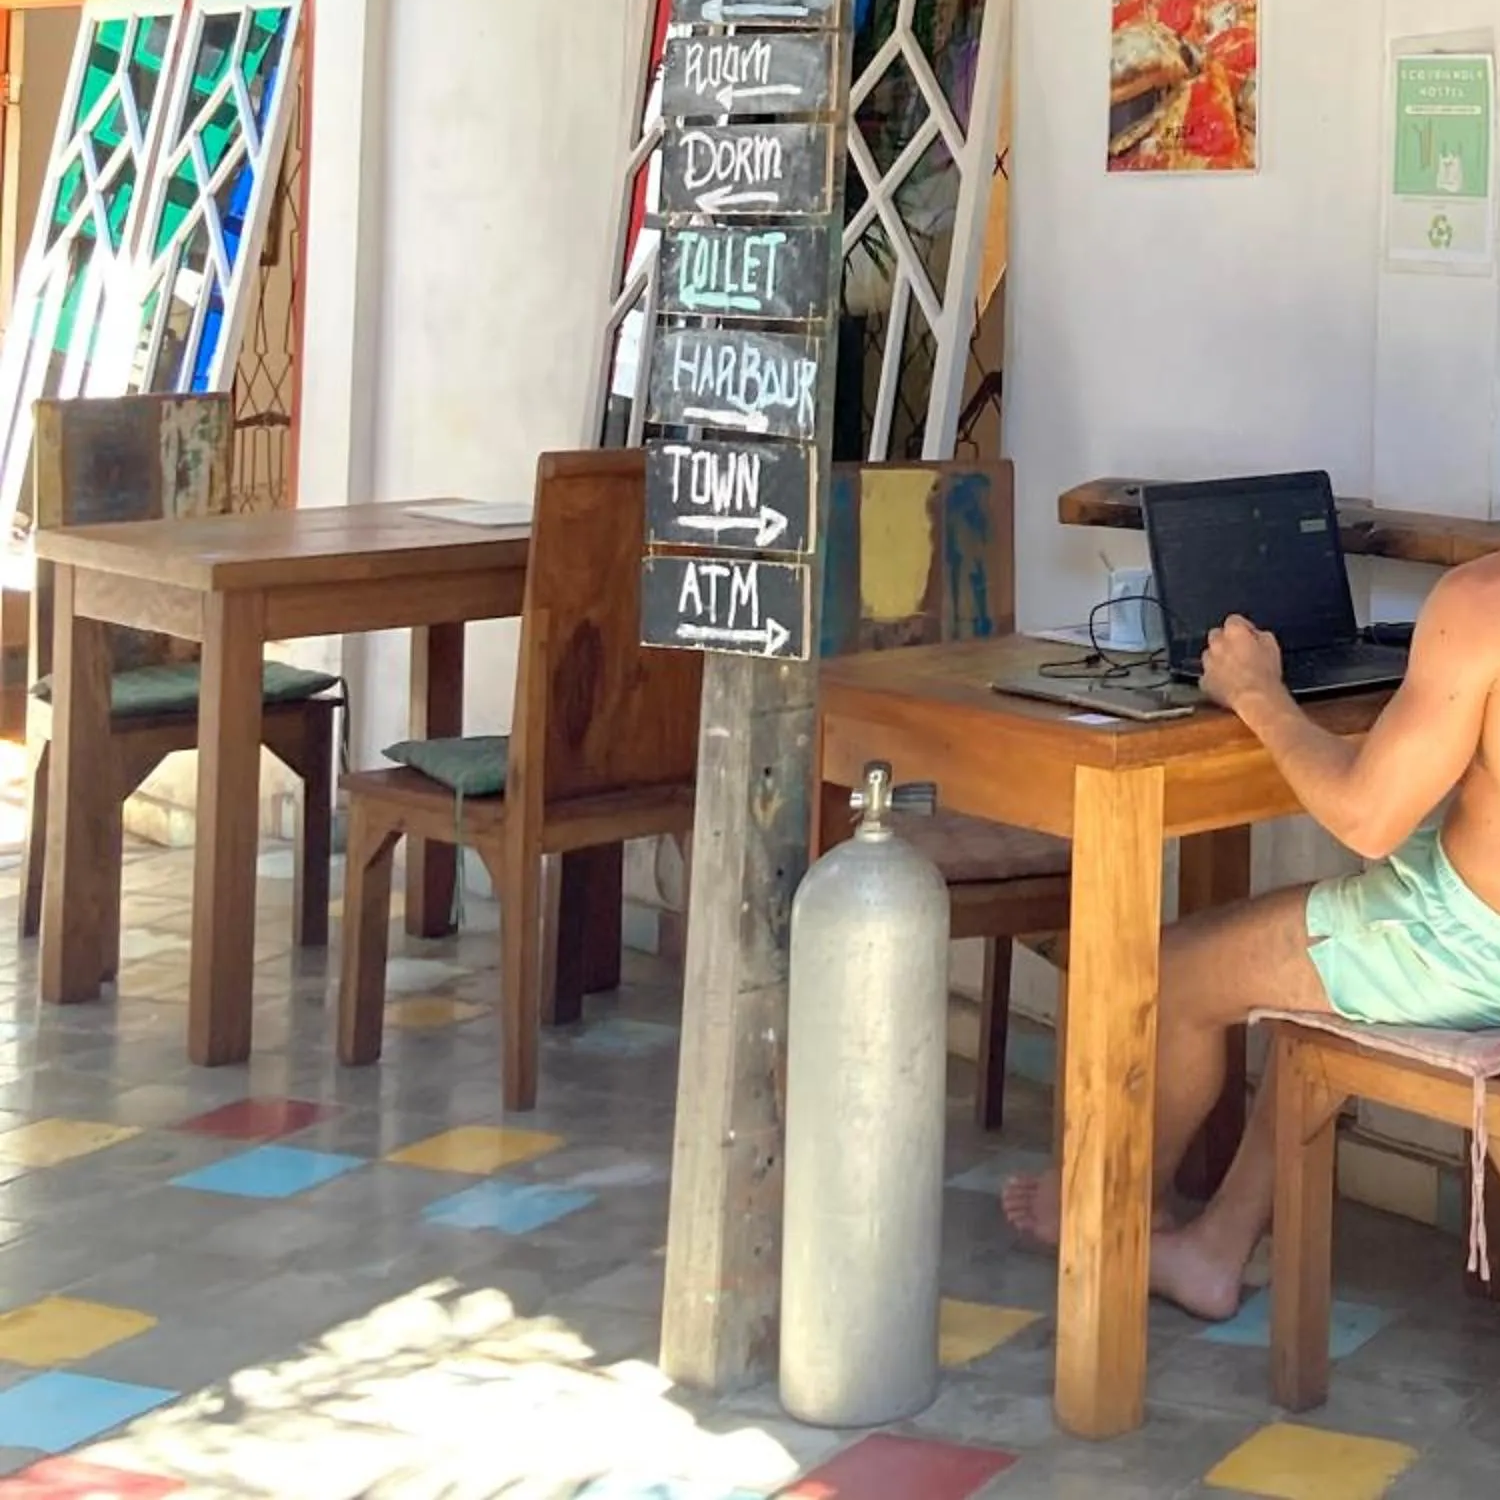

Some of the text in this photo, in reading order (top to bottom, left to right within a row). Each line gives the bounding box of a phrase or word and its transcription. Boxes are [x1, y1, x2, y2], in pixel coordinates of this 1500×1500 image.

[677, 232, 787, 301] TOILET
[672, 337, 818, 437] HARBOUR
[663, 445, 761, 513] TOWN
[678, 560, 761, 628] ATM
